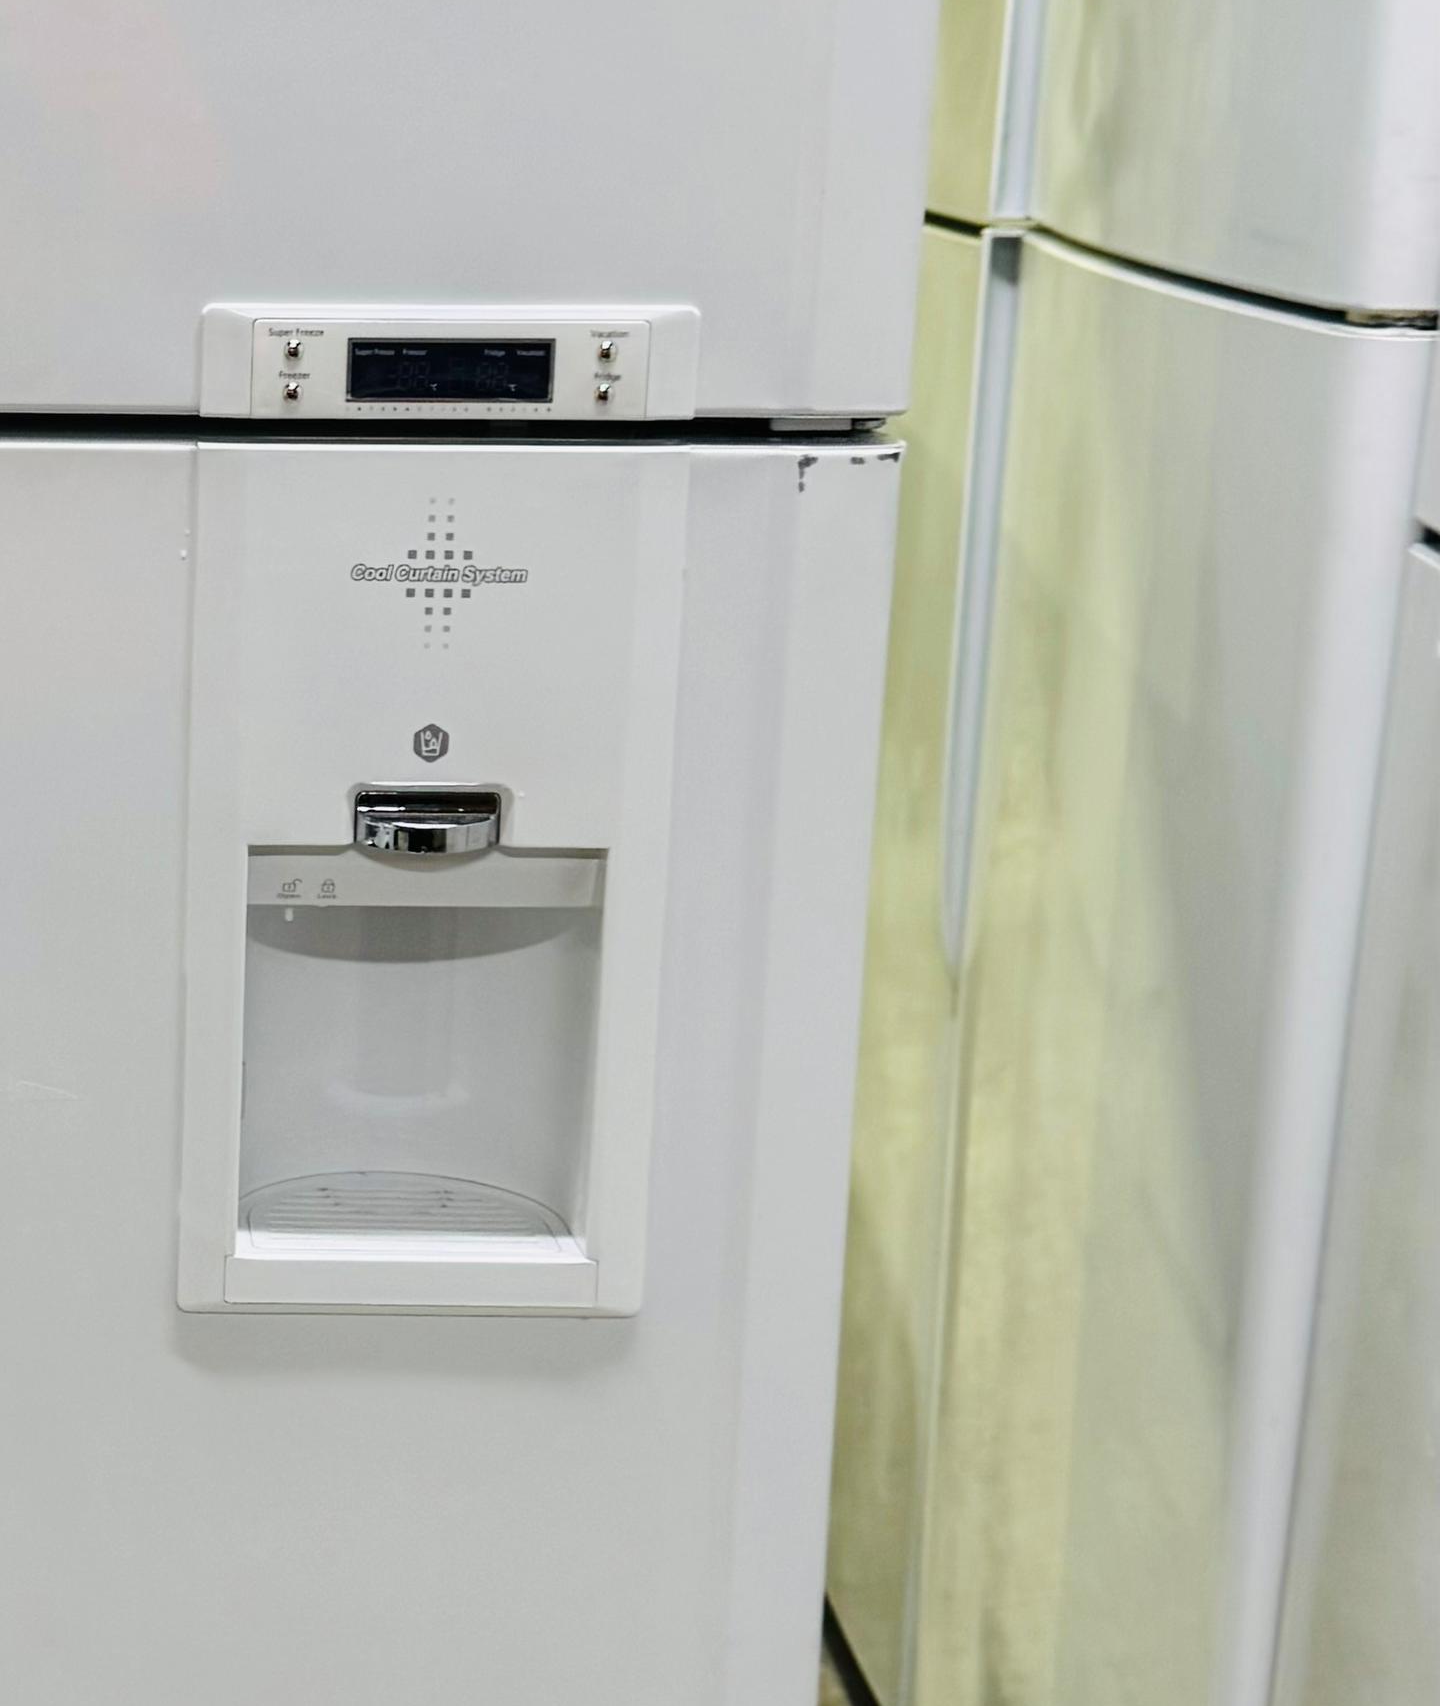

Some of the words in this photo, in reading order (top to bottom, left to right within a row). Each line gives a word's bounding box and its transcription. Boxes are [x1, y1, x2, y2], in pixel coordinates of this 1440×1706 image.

[351, 563, 394, 582] Cool
[395, 564, 459, 583] Curtain
[461, 565, 528, 586] System
